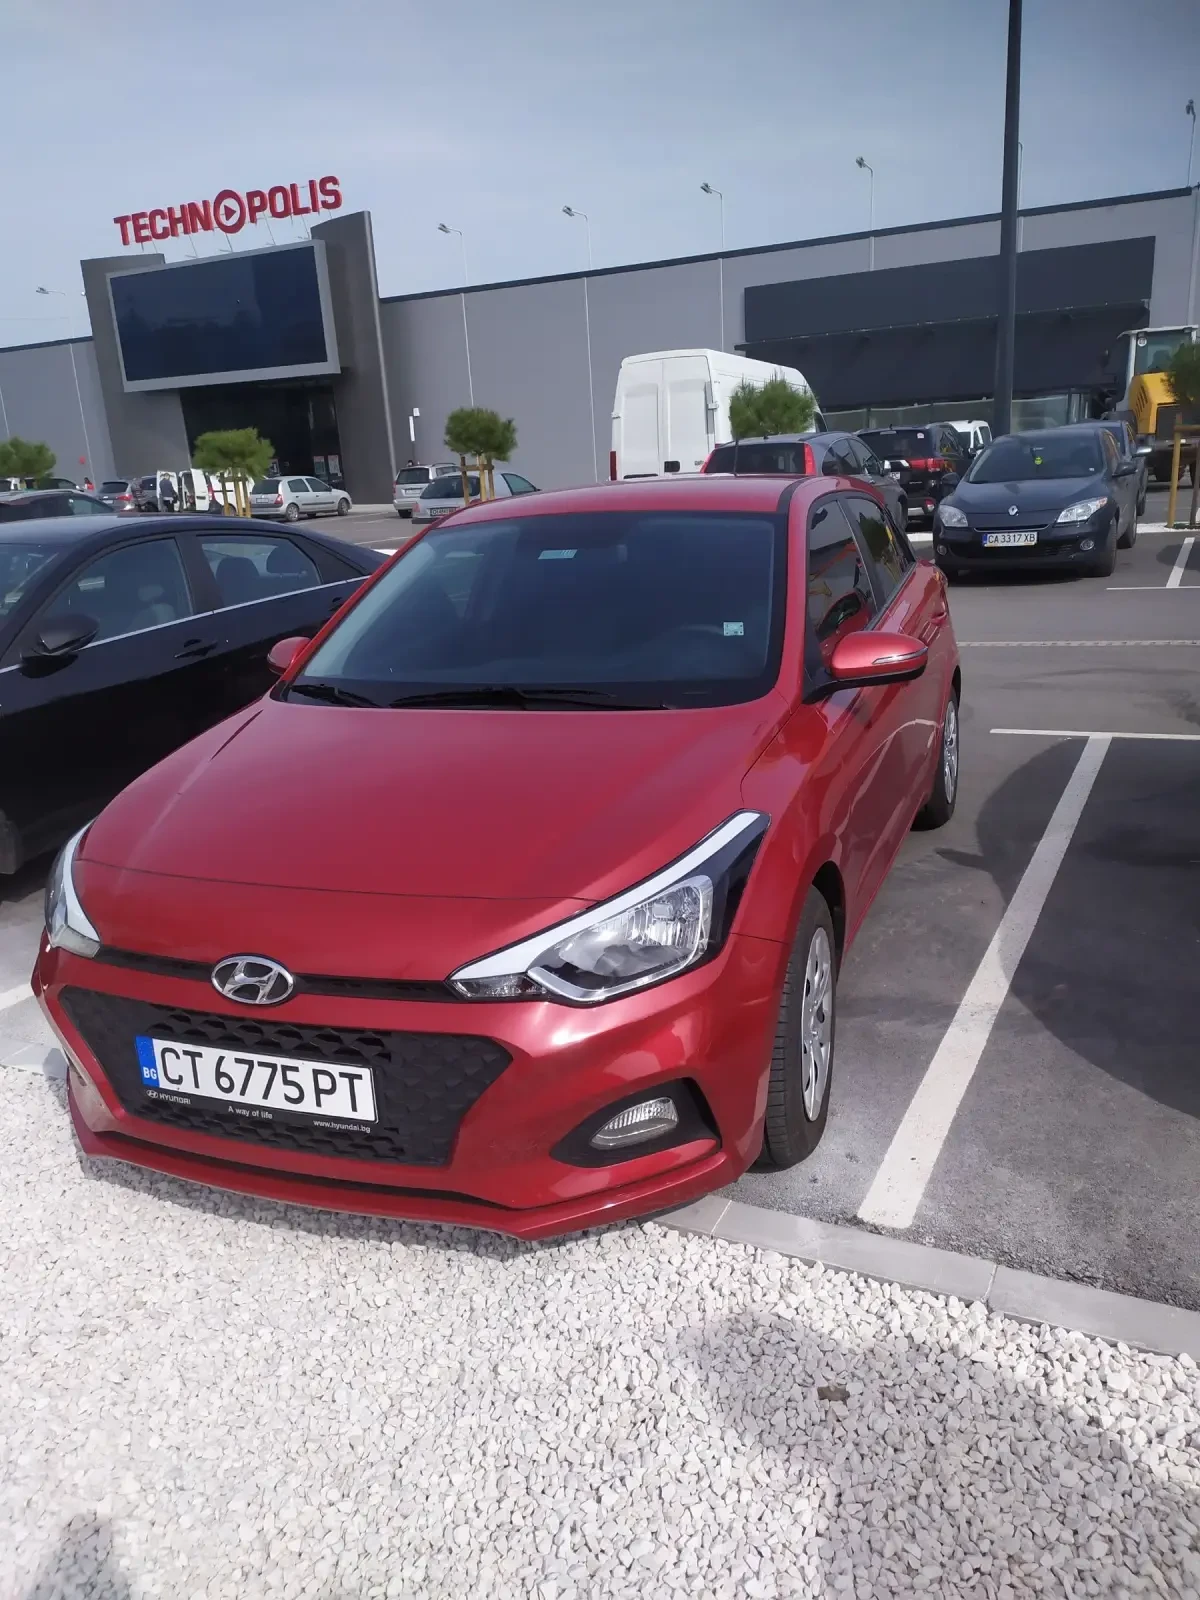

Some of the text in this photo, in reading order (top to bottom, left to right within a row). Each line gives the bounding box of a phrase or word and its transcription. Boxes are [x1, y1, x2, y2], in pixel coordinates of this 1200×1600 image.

[113, 175, 342, 246] TECHNOPOLIS
[988, 532, 1036, 544] CA 3317 XB
[143, 1066, 158, 1080] BG
[160, 1046, 363, 1113] CT 6775 PT
[159, 1094, 191, 1105] HYUNDAI
[228, 1105, 273, 1120] A way of life
[313, 1119, 371, 1134] www.hyundai.bg
